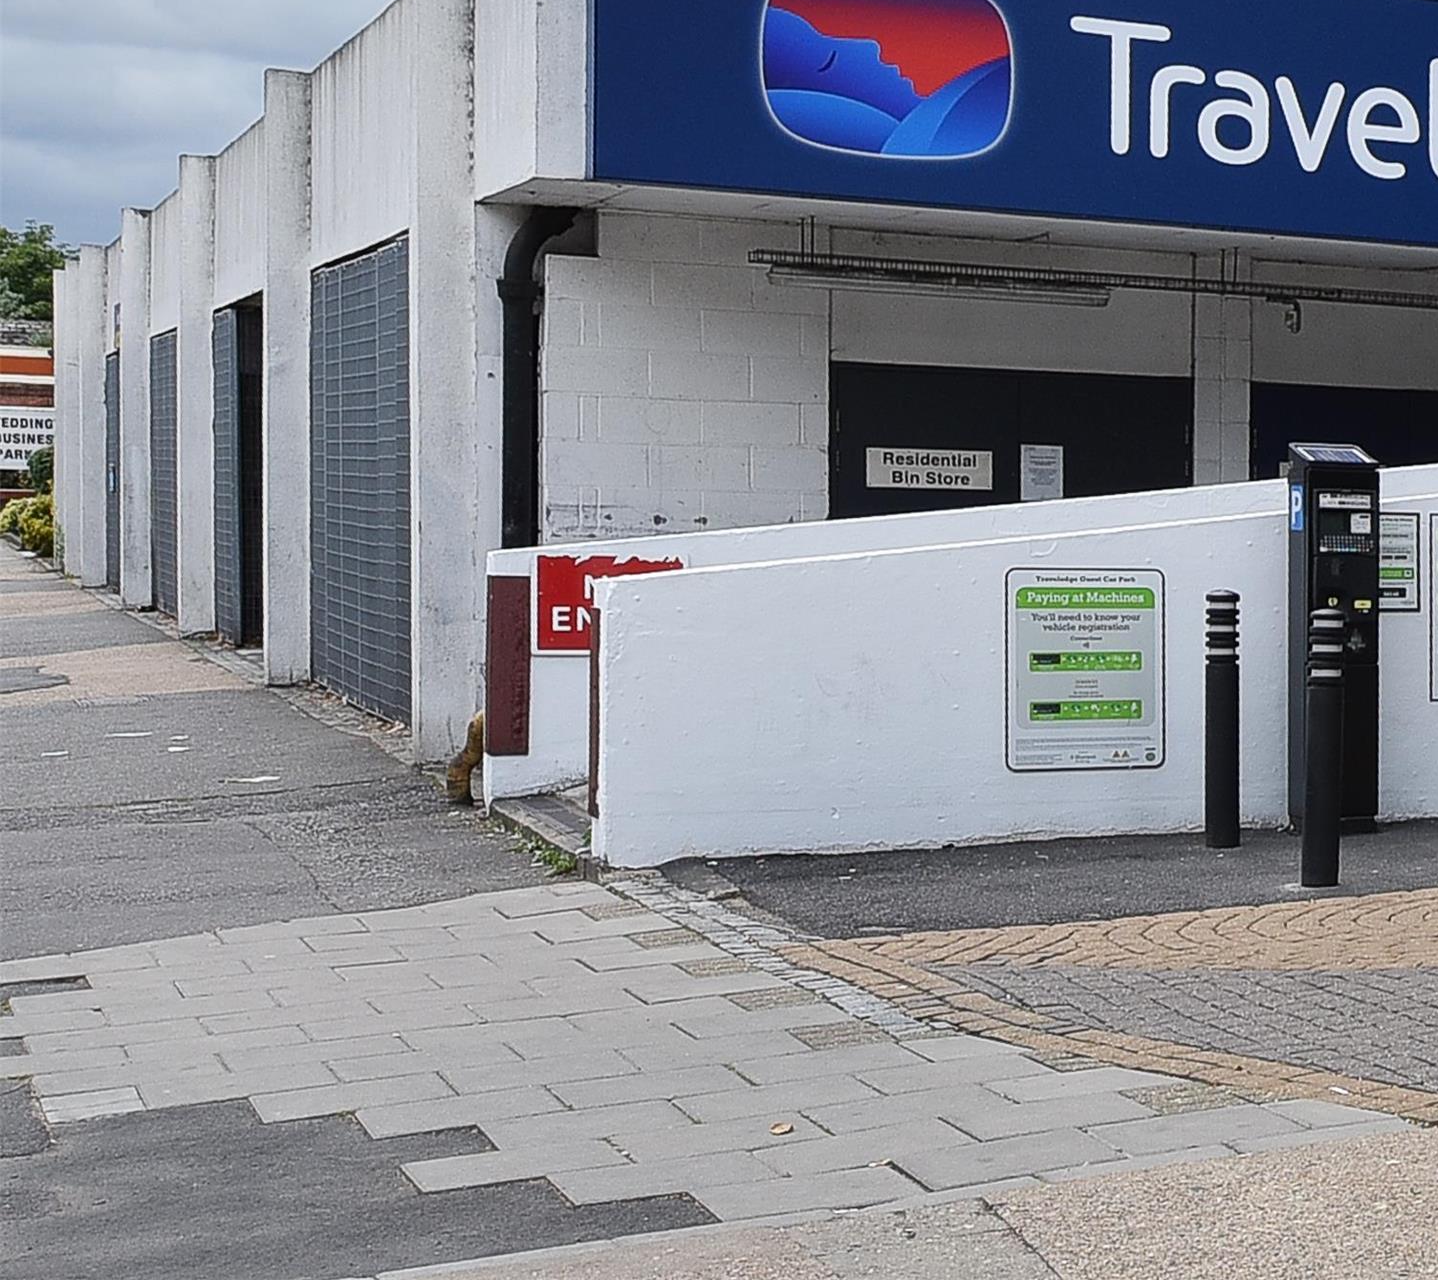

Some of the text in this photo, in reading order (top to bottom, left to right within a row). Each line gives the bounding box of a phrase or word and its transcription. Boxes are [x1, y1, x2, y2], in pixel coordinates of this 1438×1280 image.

[0, 417, 53, 429] EDDING
[882, 451, 977, 468] Residential
[892, 470, 971, 486] Bin Store
[1292, 490, 1301, 527] P
[1027, 592, 1144, 605] Paying at Machines
[1031, 613, 1141, 623] You'll need to know your
[1043, 623, 1130, 633] vehicle registration
